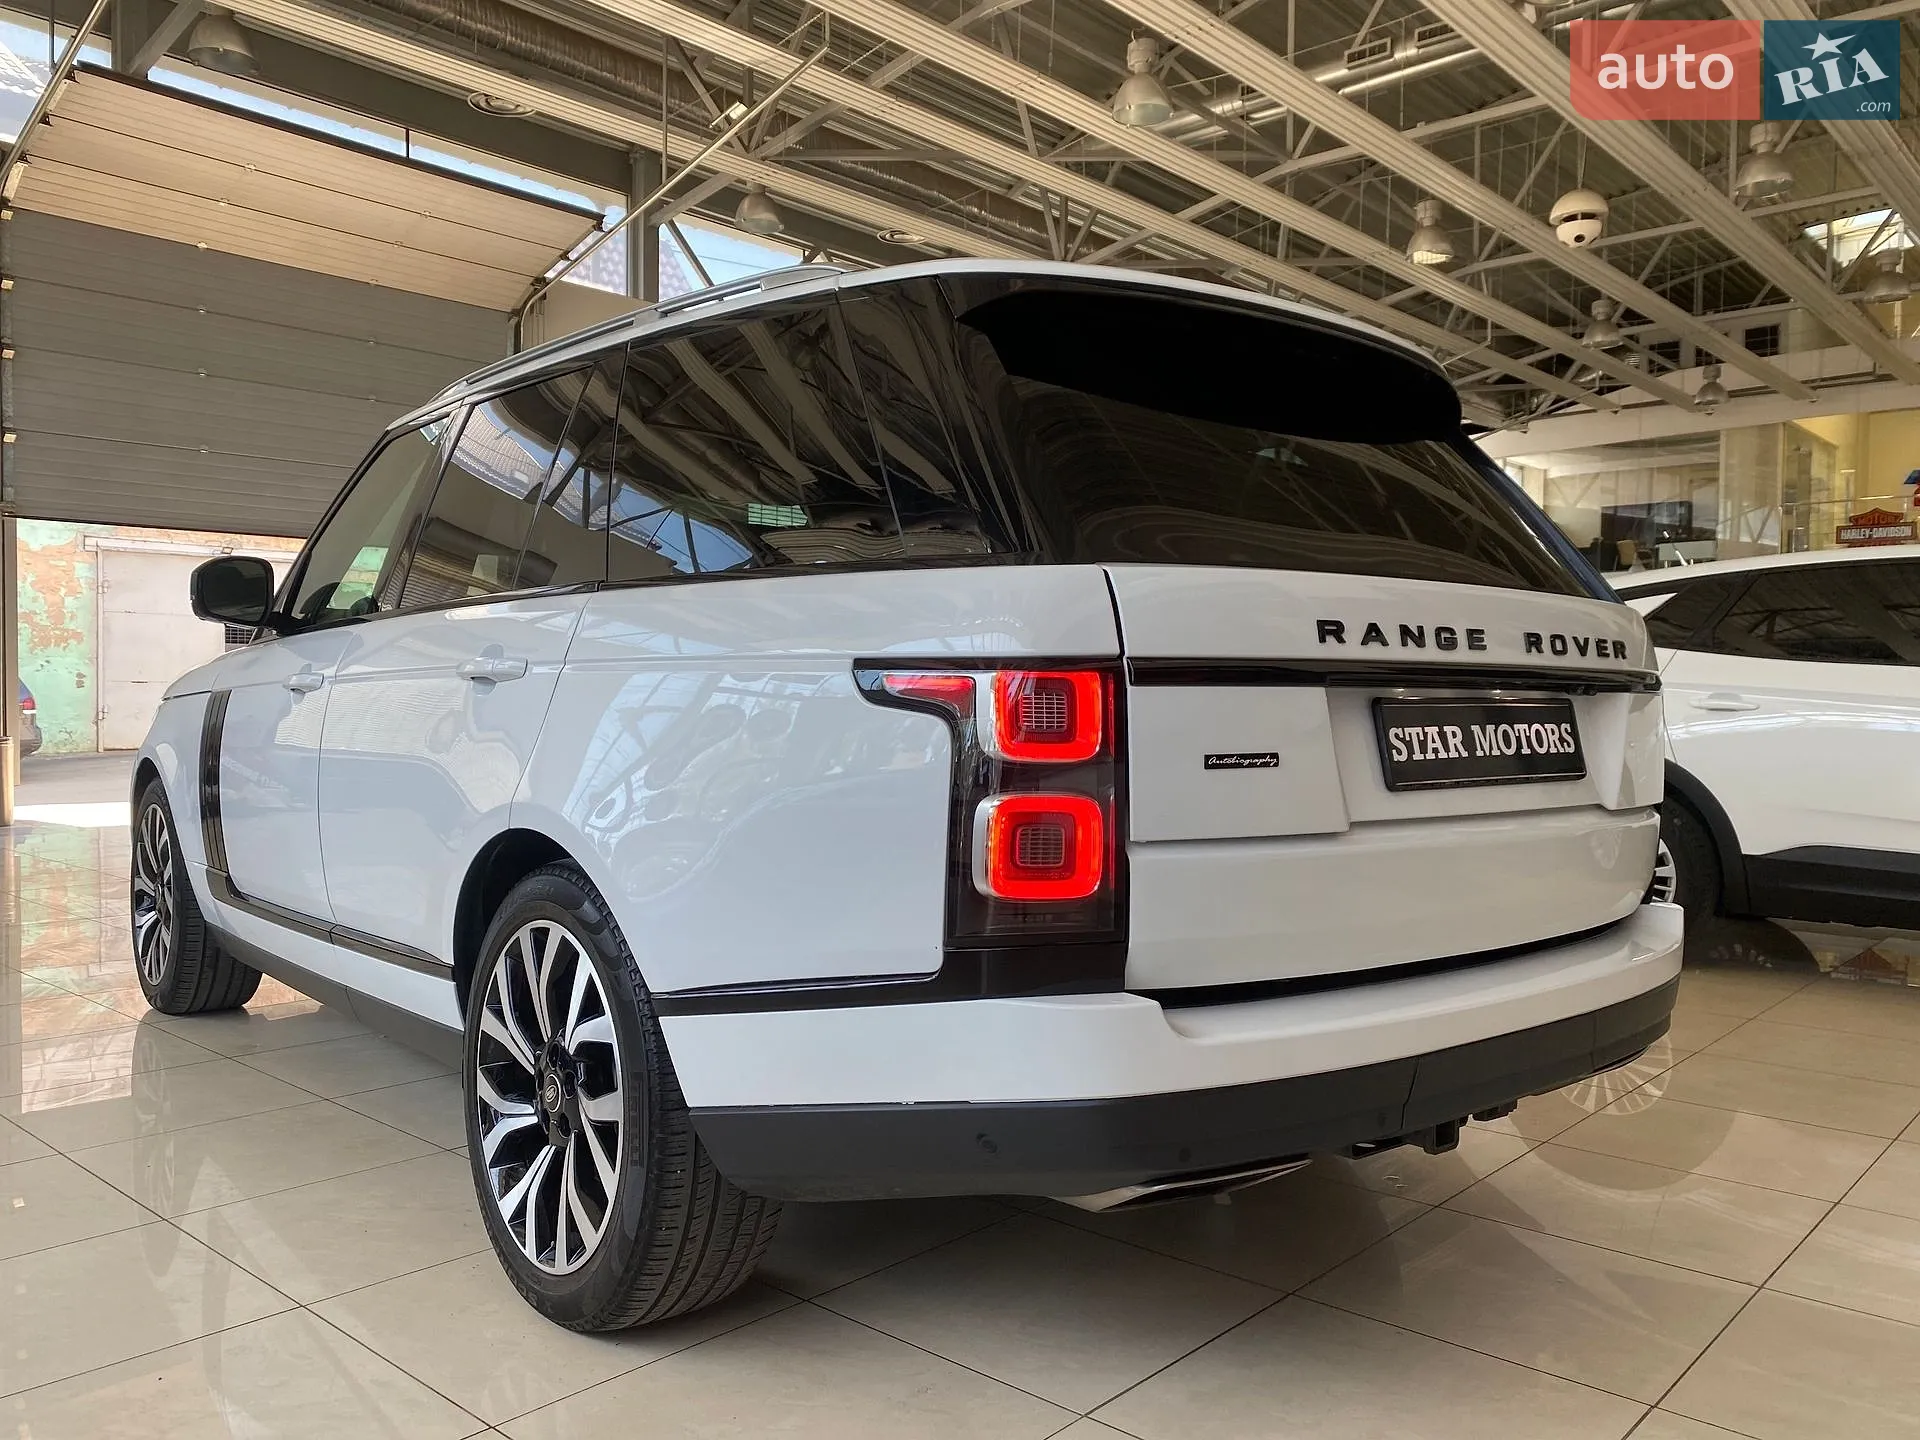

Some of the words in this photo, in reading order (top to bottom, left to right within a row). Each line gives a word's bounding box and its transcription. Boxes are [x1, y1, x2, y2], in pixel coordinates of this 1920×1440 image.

[1840, 526, 1913, 539] HARLEY-DAVIDSON
[1316, 619, 1487, 651] RANGE
[1524, 632, 1628, 660] ROVER
[1389, 725, 1469, 762] STAR
[1471, 723, 1575, 757] MOTORS
[1208, 755, 1278, 767] Autobiography
